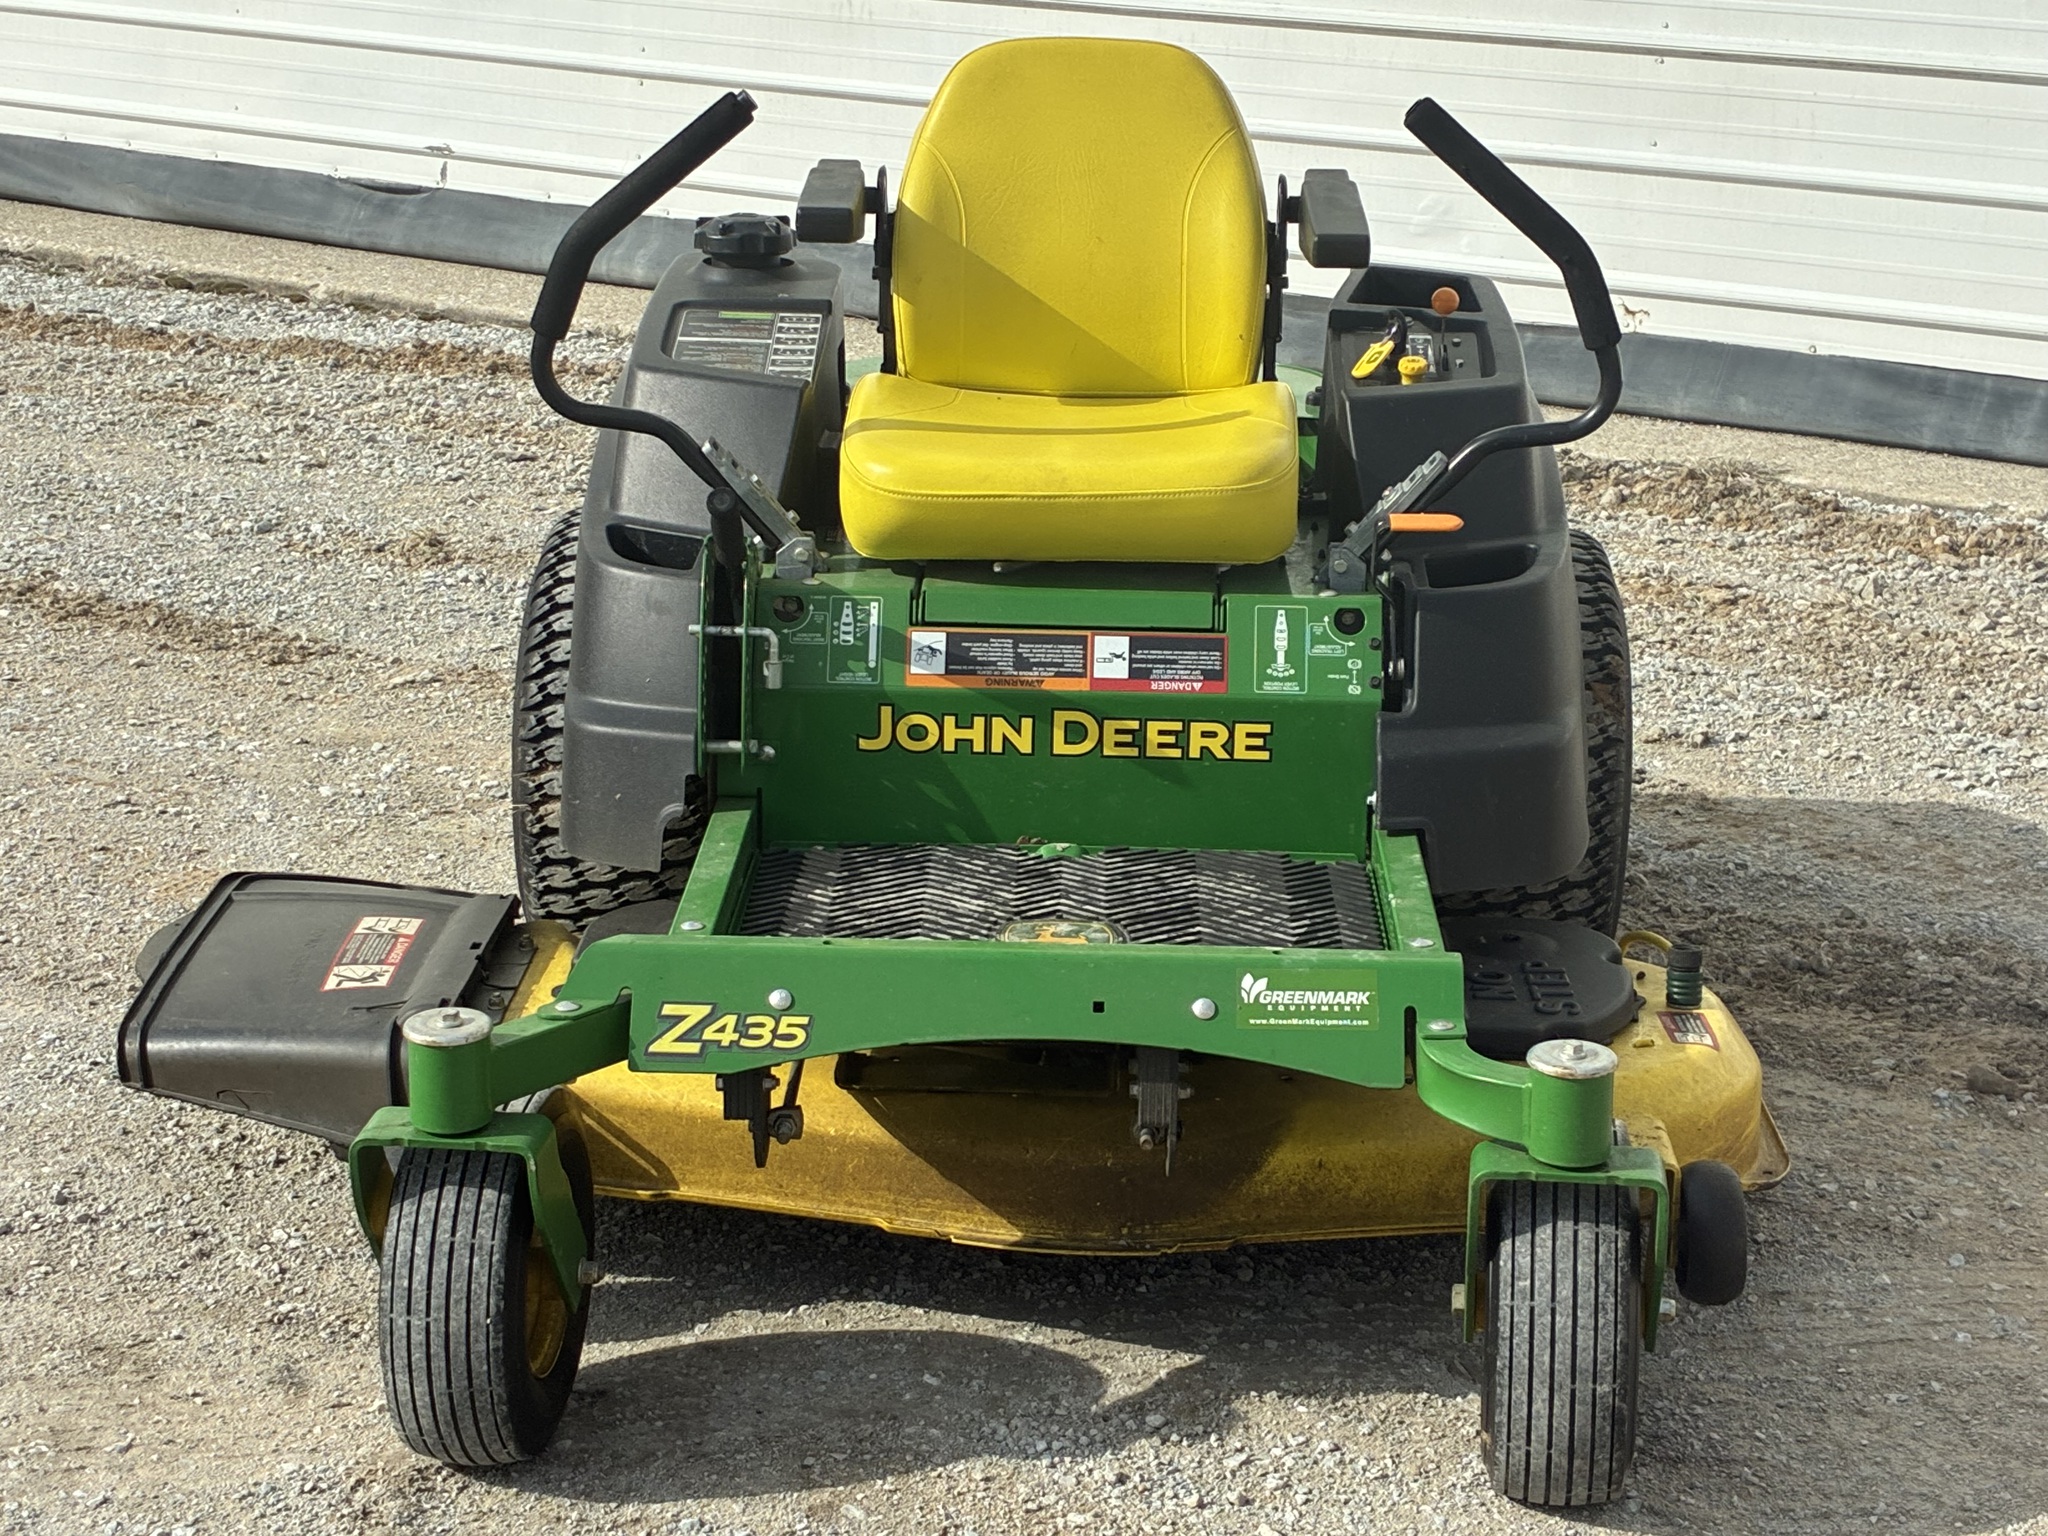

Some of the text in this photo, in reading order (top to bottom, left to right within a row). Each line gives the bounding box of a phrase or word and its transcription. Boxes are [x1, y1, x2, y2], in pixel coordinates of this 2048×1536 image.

[984, 677, 1034, 687] WARNING
[1150, 681, 1193, 690] DANGER
[856, 703, 1274, 762] JOHN DEERE
[1470, 969, 1517, 1001] NO
[1522, 960, 1582, 1016] STEP
[1259, 990, 1370, 1005] GREENMARK
[646, 1002, 812, 1055] Z435
[1248, 1018, 1370, 1026] www.GreenMarkEquipment.com
